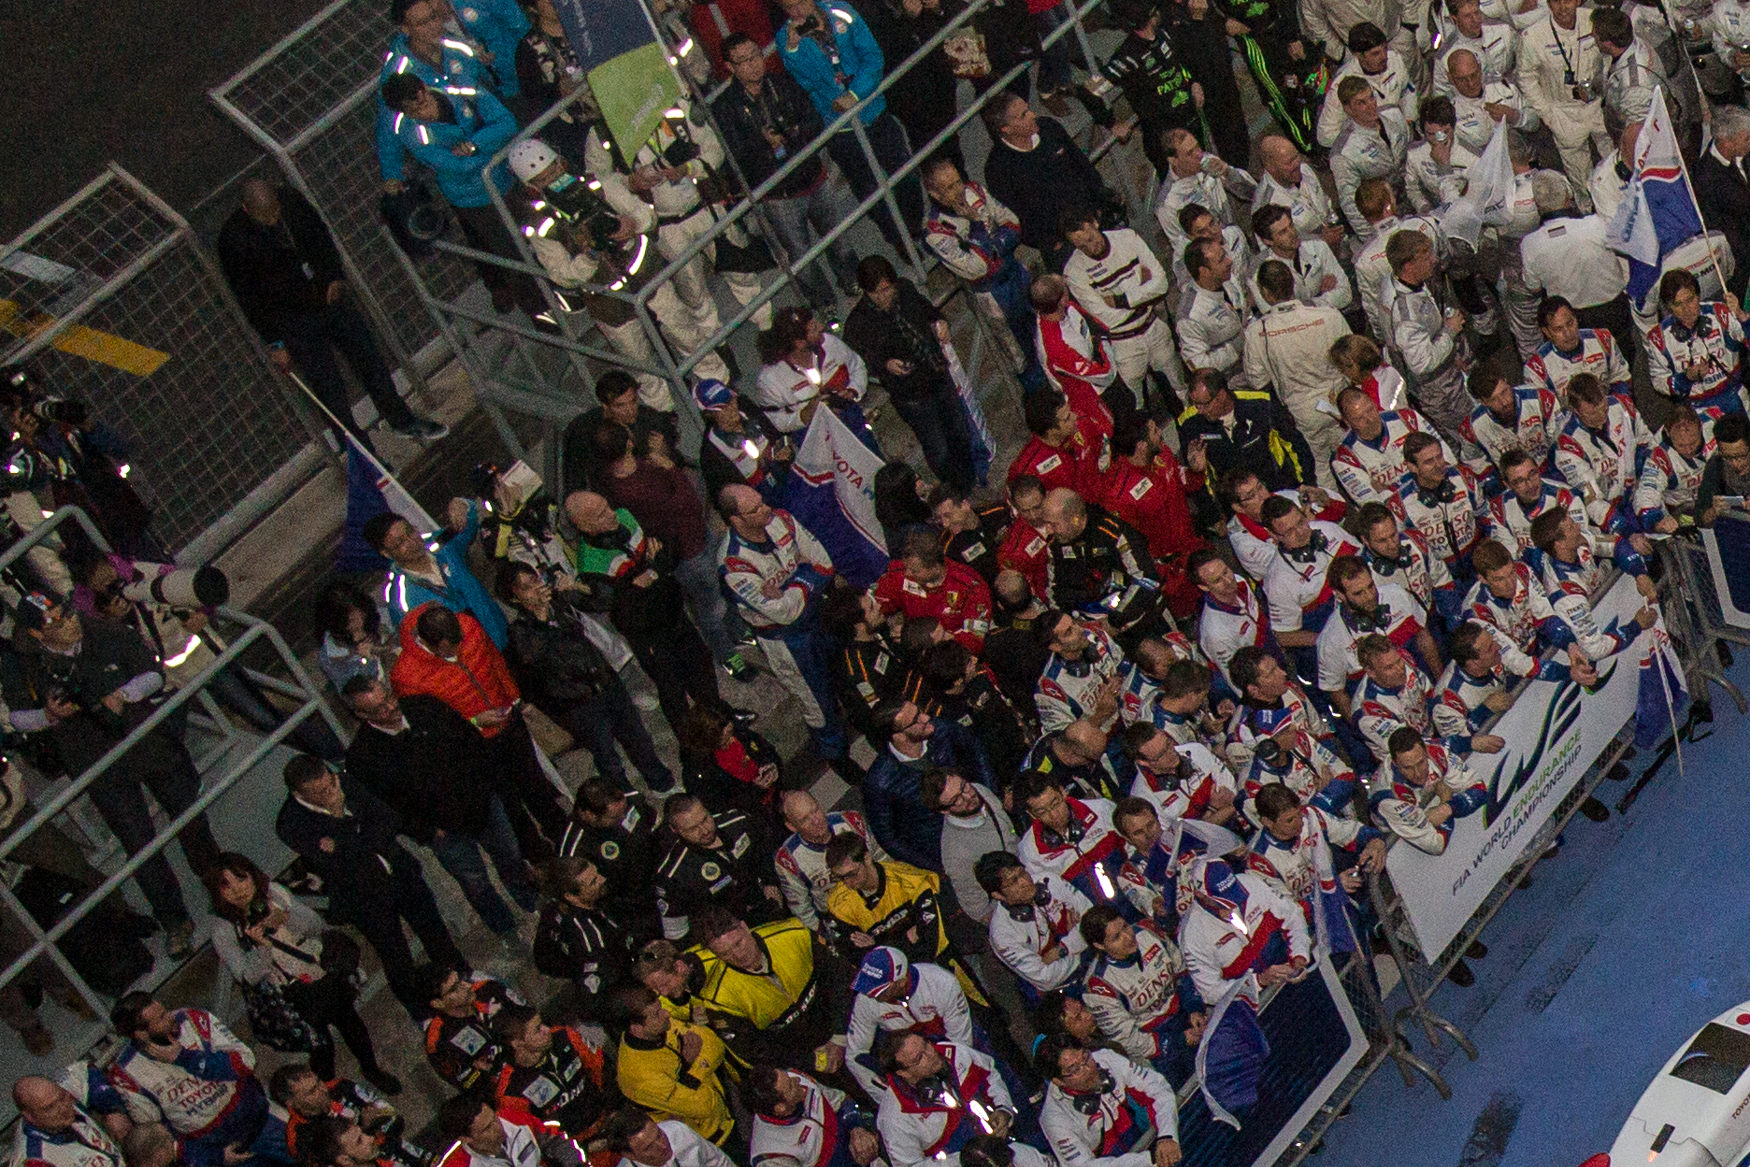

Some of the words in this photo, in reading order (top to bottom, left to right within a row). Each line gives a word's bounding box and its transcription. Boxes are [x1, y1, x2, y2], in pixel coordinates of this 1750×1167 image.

[1452, 868, 1471, 896] FIA
[1473, 816, 1512, 868] WORLD
[1513, 727, 1582, 820] ENDURANCE
[1502, 744, 1582, 850] CHAMPIONSHIP
[1136, 961, 1174, 1008] DENSO
